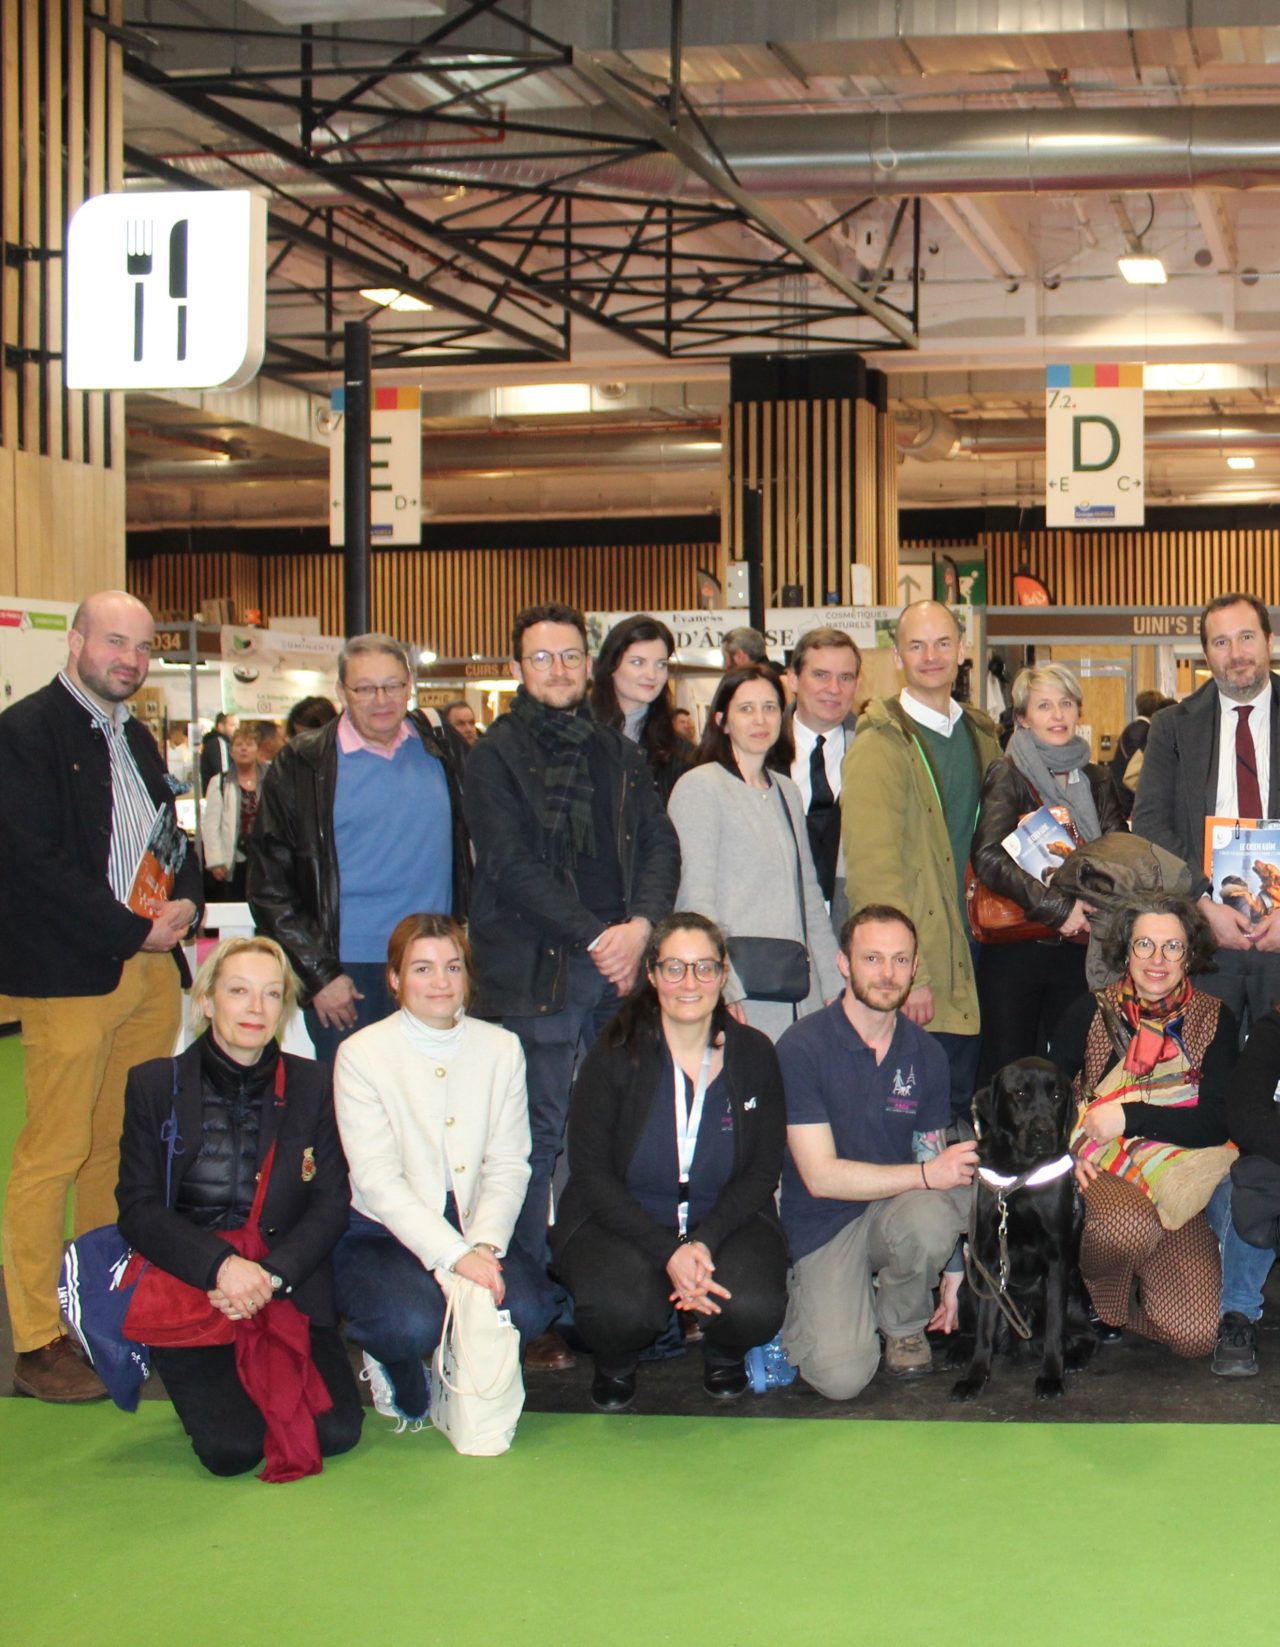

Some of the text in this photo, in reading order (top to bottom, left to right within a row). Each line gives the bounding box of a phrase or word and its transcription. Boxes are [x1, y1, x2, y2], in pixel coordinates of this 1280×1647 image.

[1072, 415, 1121, 472] D
[1060, 477, 1069, 492] E
[1117, 476, 1130, 491] C
[395, 496, 407, 510] D
[1133, 615, 1188, 634] UINI'S
[465, 664, 499, 676] CUIRS
